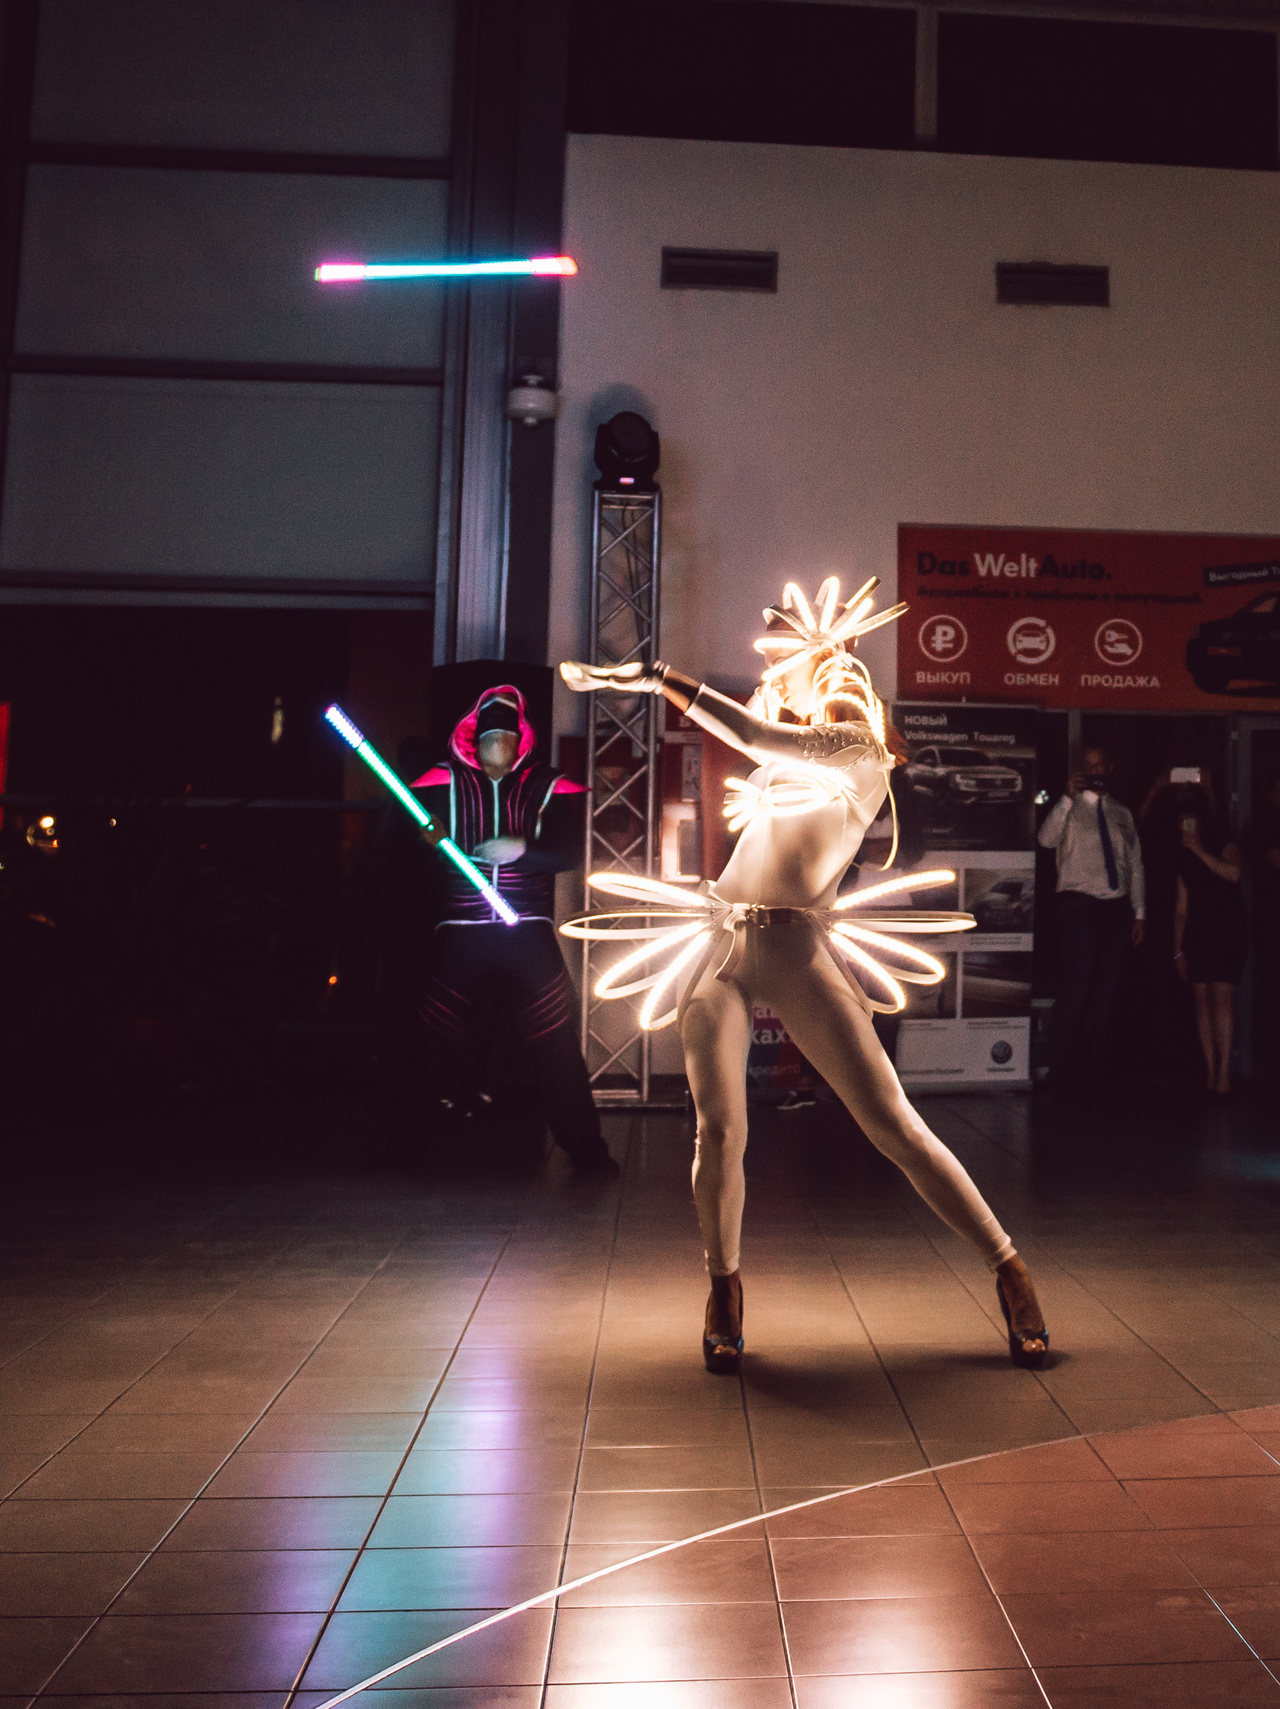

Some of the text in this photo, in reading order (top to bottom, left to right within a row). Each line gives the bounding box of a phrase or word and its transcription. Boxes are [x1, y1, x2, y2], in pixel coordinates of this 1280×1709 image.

[917, 551, 970, 577] Das
[915, 671, 1160, 688] ВЫКУП ОБМЕН ПРОДАЖА
[904, 730, 1016, 745] Volkswagen Touareg
